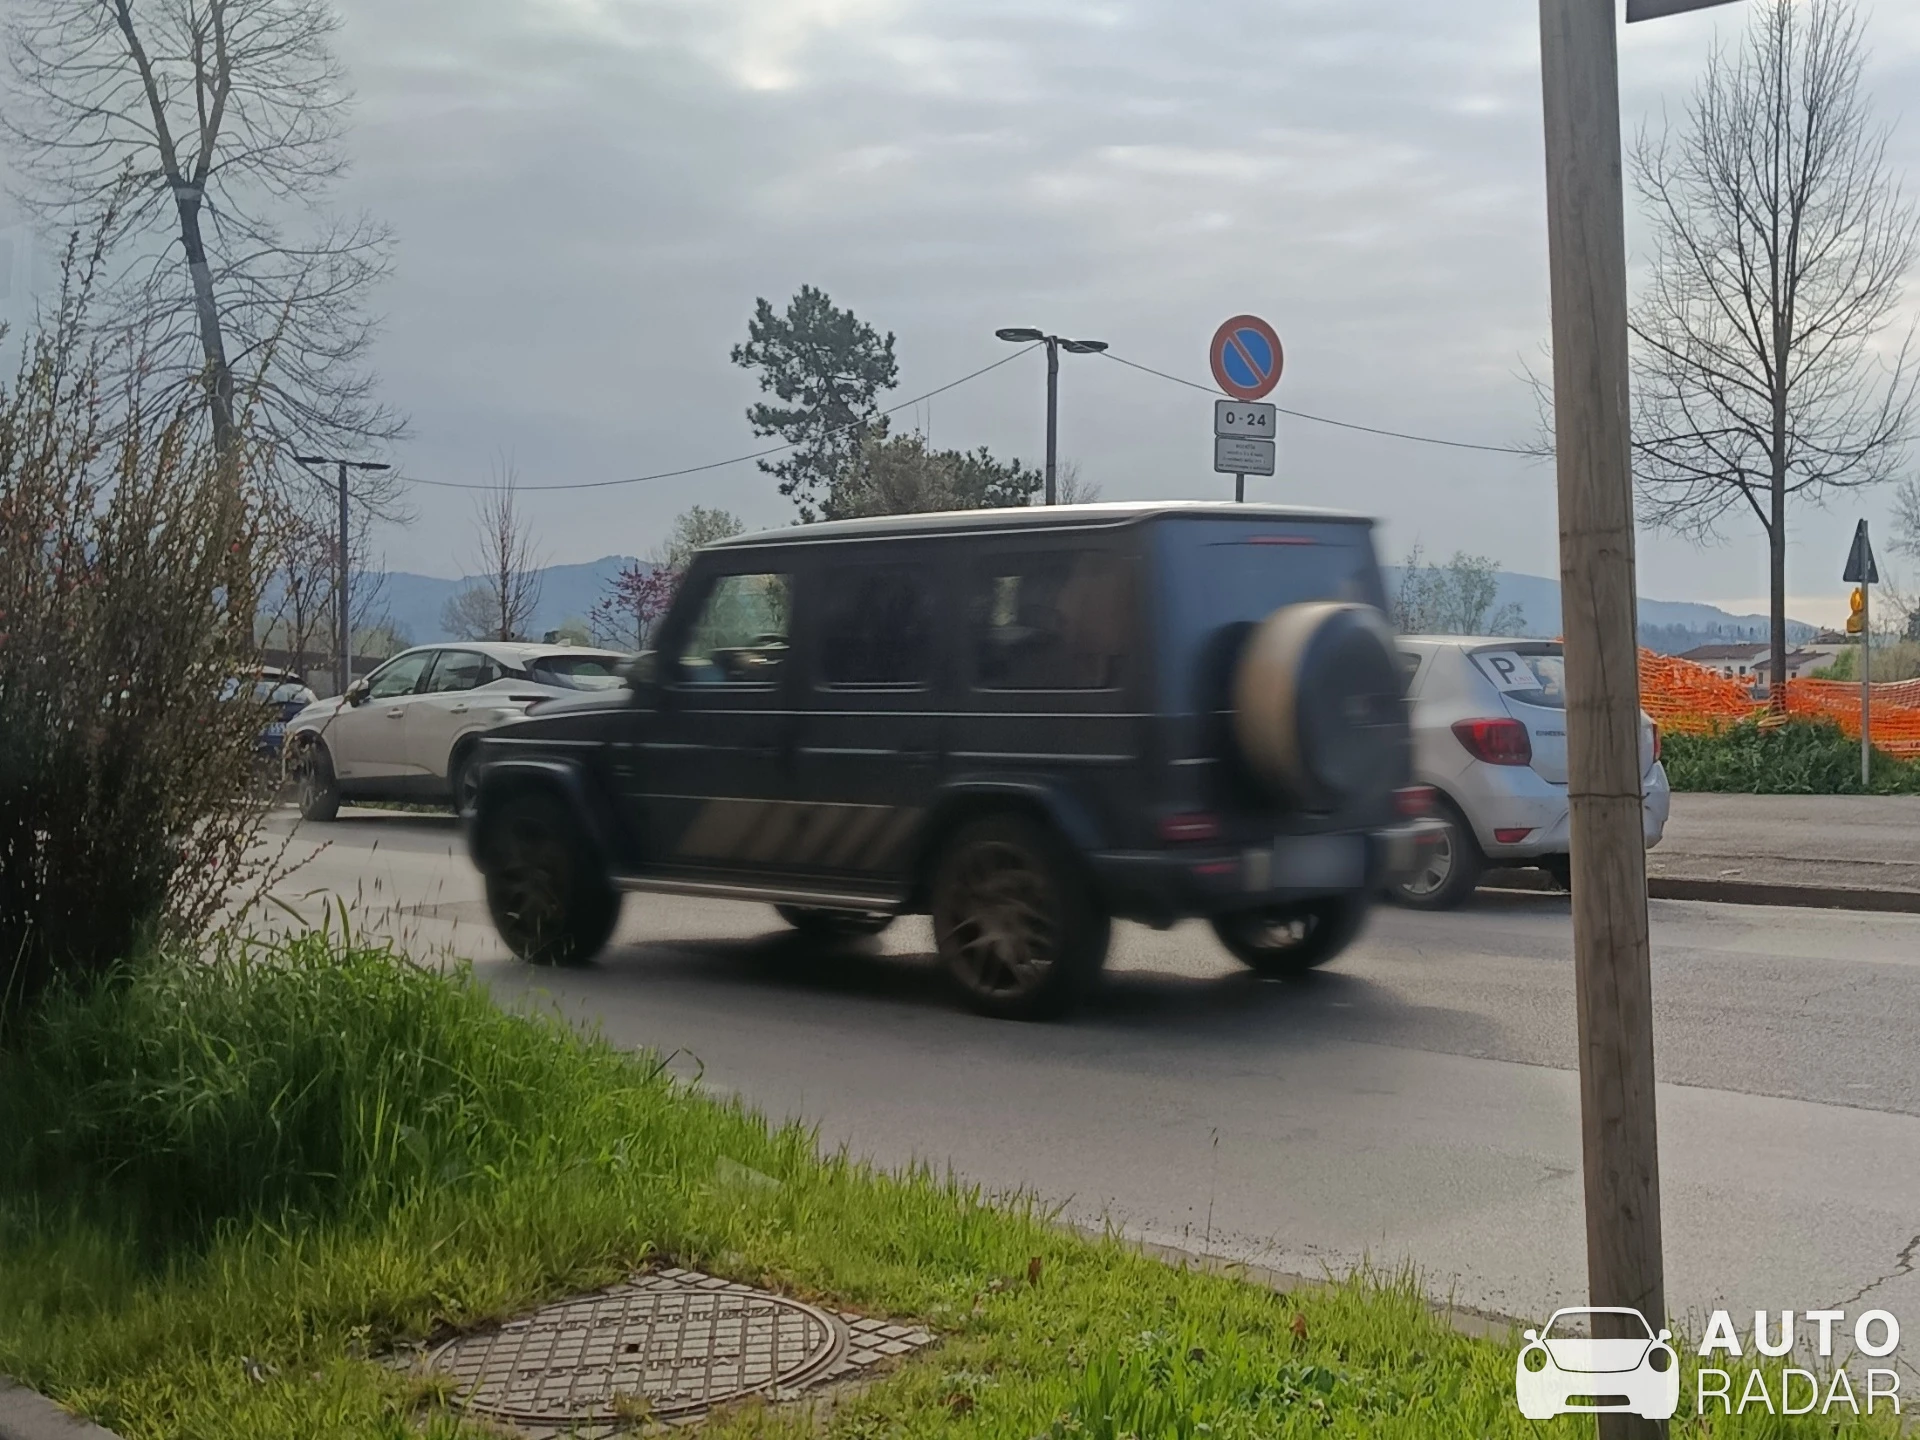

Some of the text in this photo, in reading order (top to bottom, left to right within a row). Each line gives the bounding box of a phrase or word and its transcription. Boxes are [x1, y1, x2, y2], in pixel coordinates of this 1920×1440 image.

[1226, 411, 1235, 424] 0
[1247, 413, 1266, 426] 24
[1489, 657, 1515, 684] P
